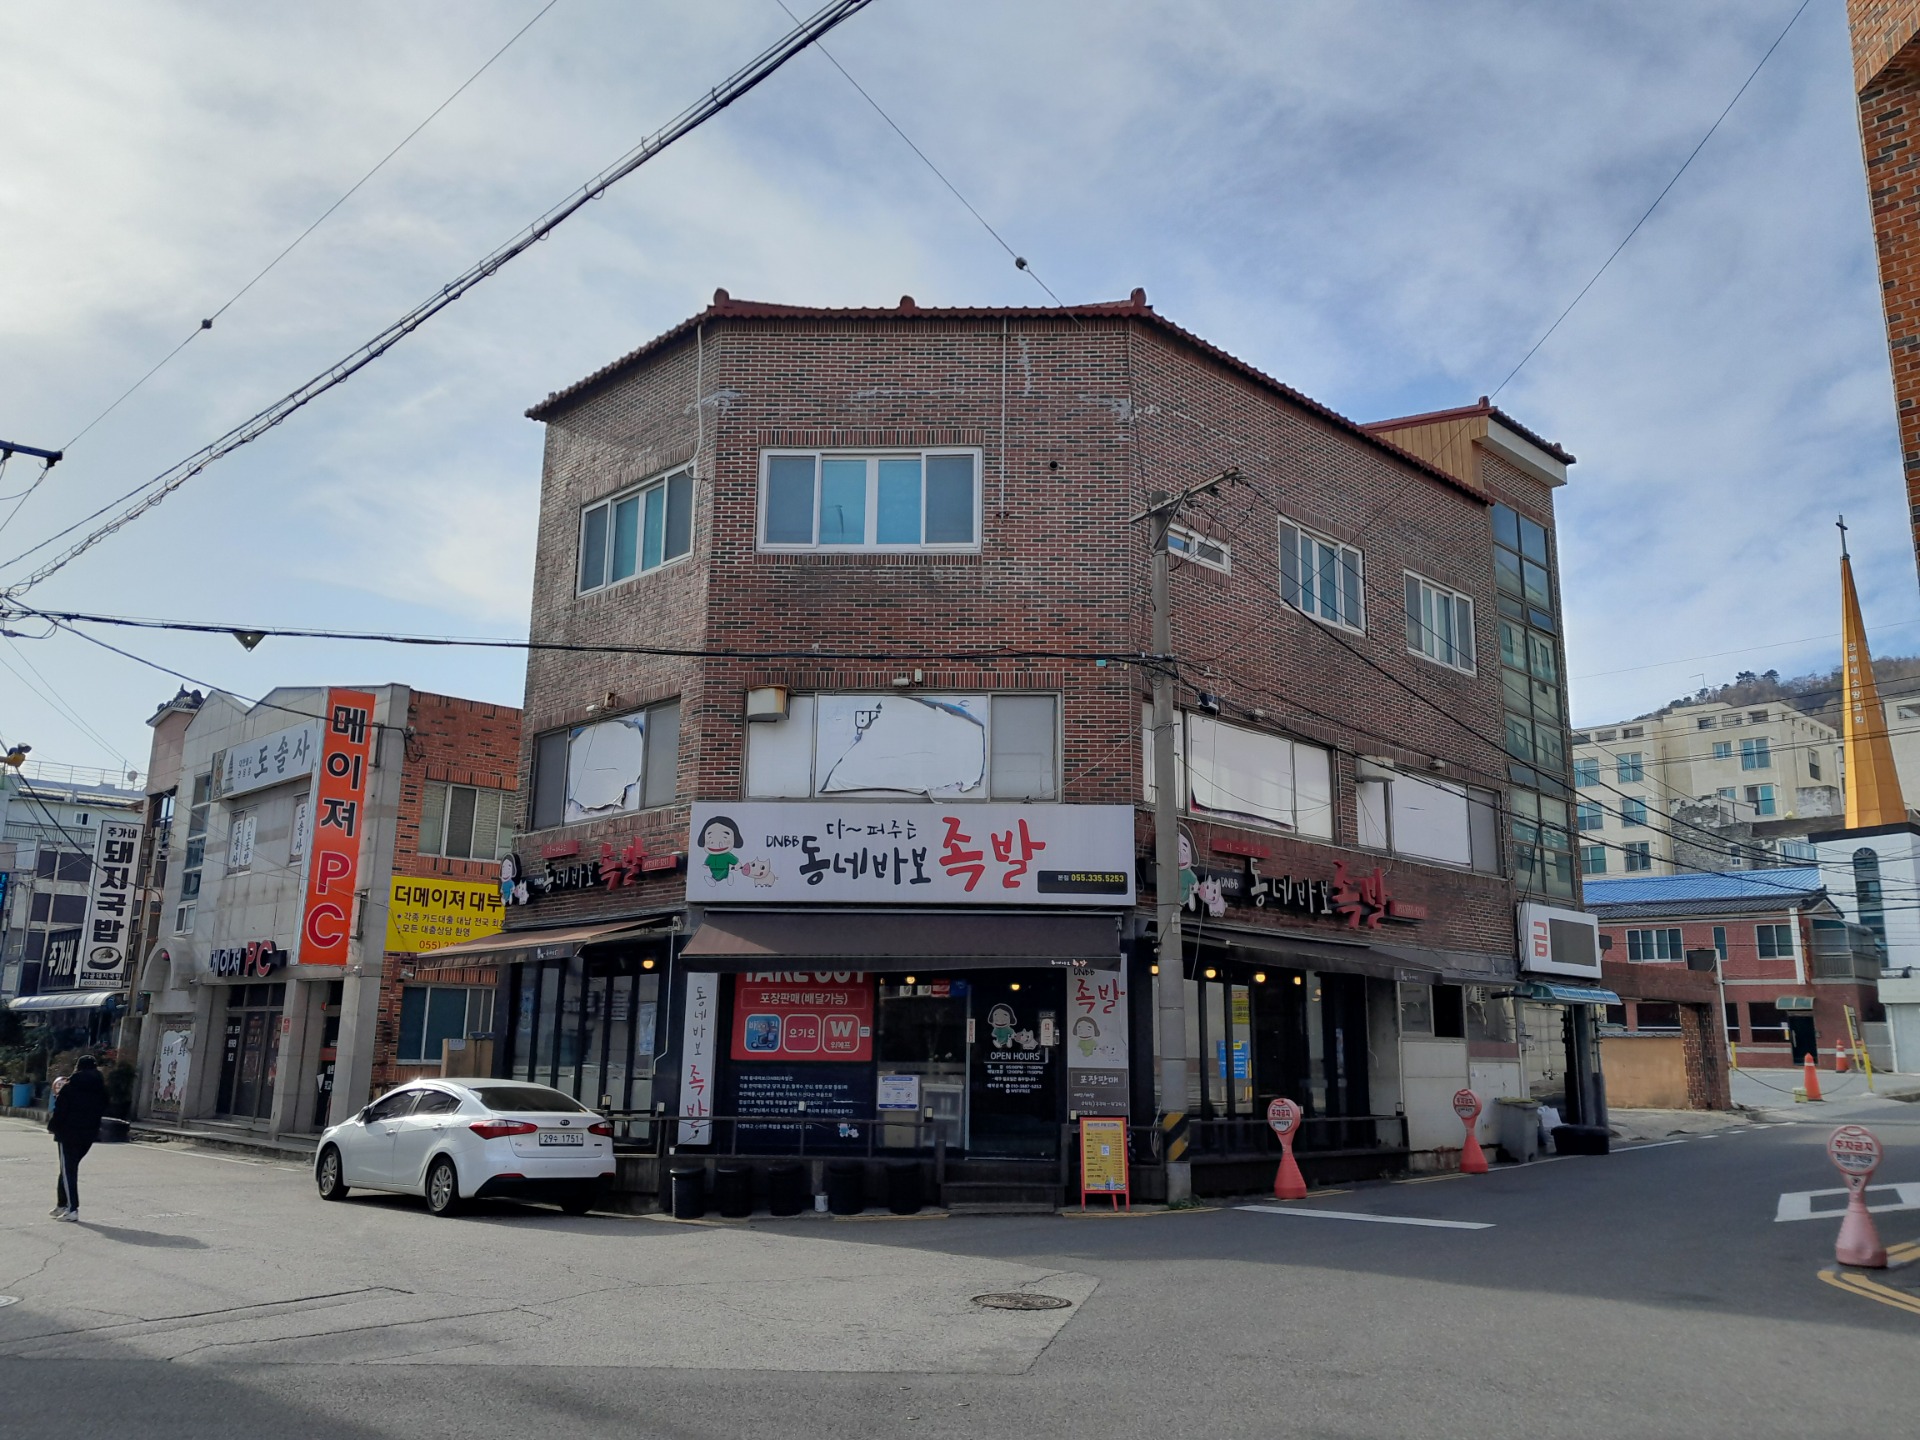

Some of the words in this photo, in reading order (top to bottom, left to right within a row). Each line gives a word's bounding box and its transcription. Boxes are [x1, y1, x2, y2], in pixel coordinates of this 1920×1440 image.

[253, 729, 311, 779] 도솔사
[320, 705, 367, 838] 메이져
[107, 826, 138, 840] 주가네
[543, 861, 594, 893] 동네바보
[598, 836, 650, 891] 족발
[766, 834, 800, 849] DNBB
[799, 834, 932, 886] 동네바보
[938, 816, 1047, 893] 족발
[92, 839, 135, 944] 돼지국밥
[1071, 873, 1125, 883] 055.335.5253
[1220, 876, 1239, 890] DNBB
[1250, 857, 1333, 915] 동네바보
[1331, 859, 1393, 930] 족발
[306, 851, 352, 950] PC
[394, 885, 466, 911] 더메이져
[469, 891, 503, 913] 대부
[402, 924, 418, 934] 모든
[421, 925, 453, 936] 대출상담
[244, 939, 273, 977] PC
[1075, 978, 1127, 1015] 족발
[692, 986, 708, 1056] 동네바보
[788, 1028, 817, 1038] 요기요
[829, 1020, 854, 1038] W
[990, 1051, 1012, 1060] OPEN
[1013, 1052, 1041, 1061] HOURS
[685, 1064, 709, 1129] 족발
[1080, 1074, 1119, 1085] 포장판매
[562, 1134, 579, 1143] 1751
[1835, 1139, 1873, 1152] 주차금지
